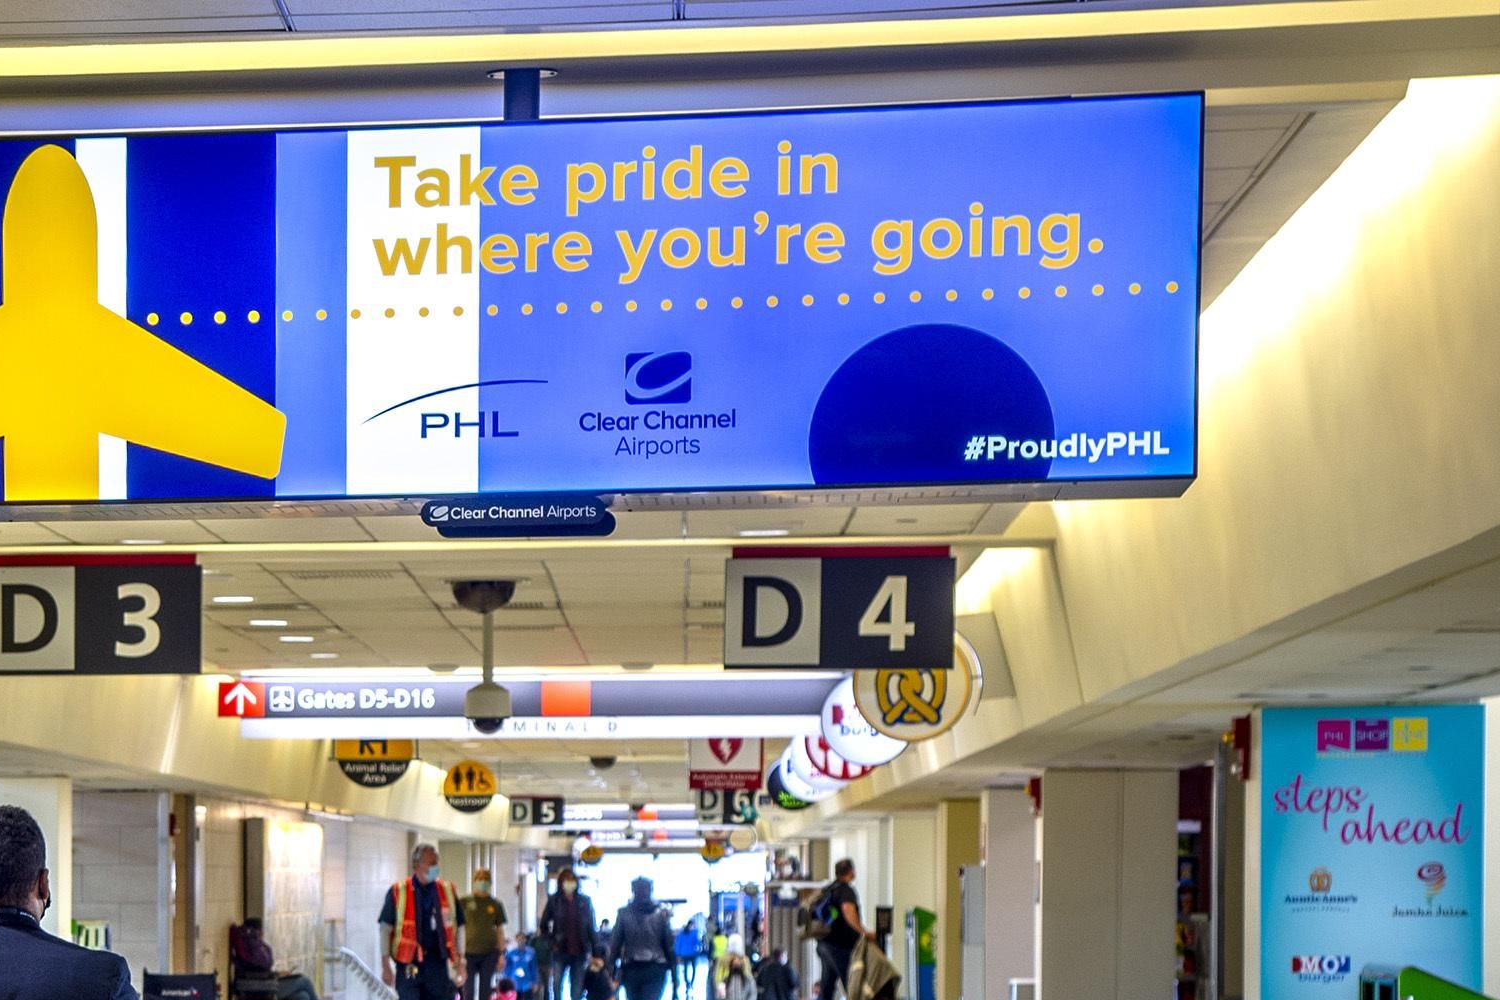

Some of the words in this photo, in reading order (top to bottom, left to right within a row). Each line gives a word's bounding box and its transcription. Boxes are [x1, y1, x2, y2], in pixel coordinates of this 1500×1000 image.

[374, 153, 539, 208] Take
[566, 145, 749, 216] pride
[777, 140, 838, 195] in
[372, 223, 592, 276] where
[615, 211, 846, 284] you're
[871, 201, 1104, 275] going.
[421, 411, 519, 438] PHL
[579, 412, 639, 432] Clear
[643, 409, 736, 431] Channel
[615, 435, 700, 460] Airports
[964, 431, 1169, 463] #ProudlyPHL
[451, 507, 486, 519] Clear
[488, 505, 543, 519] Channel
[547, 504, 597, 520] Airports
[1, 584, 58, 653] D
[114, 583, 161, 658] 3
[742, 576, 803, 647] D
[858, 575, 916, 651] 4
[297, 686, 356, 710] Gates
[359, 687, 436, 709] D5-D16
[344, 763, 377, 773] Animal
[380, 763, 406, 773] Relief
[363, 773, 387, 783] Area
[512, 804, 527, 822] D
[540, 802, 555, 823] 5
[700, 791, 718, 811] D
[1273, 773, 1368, 832] steps
[1341, 801, 1471, 845] ahead
